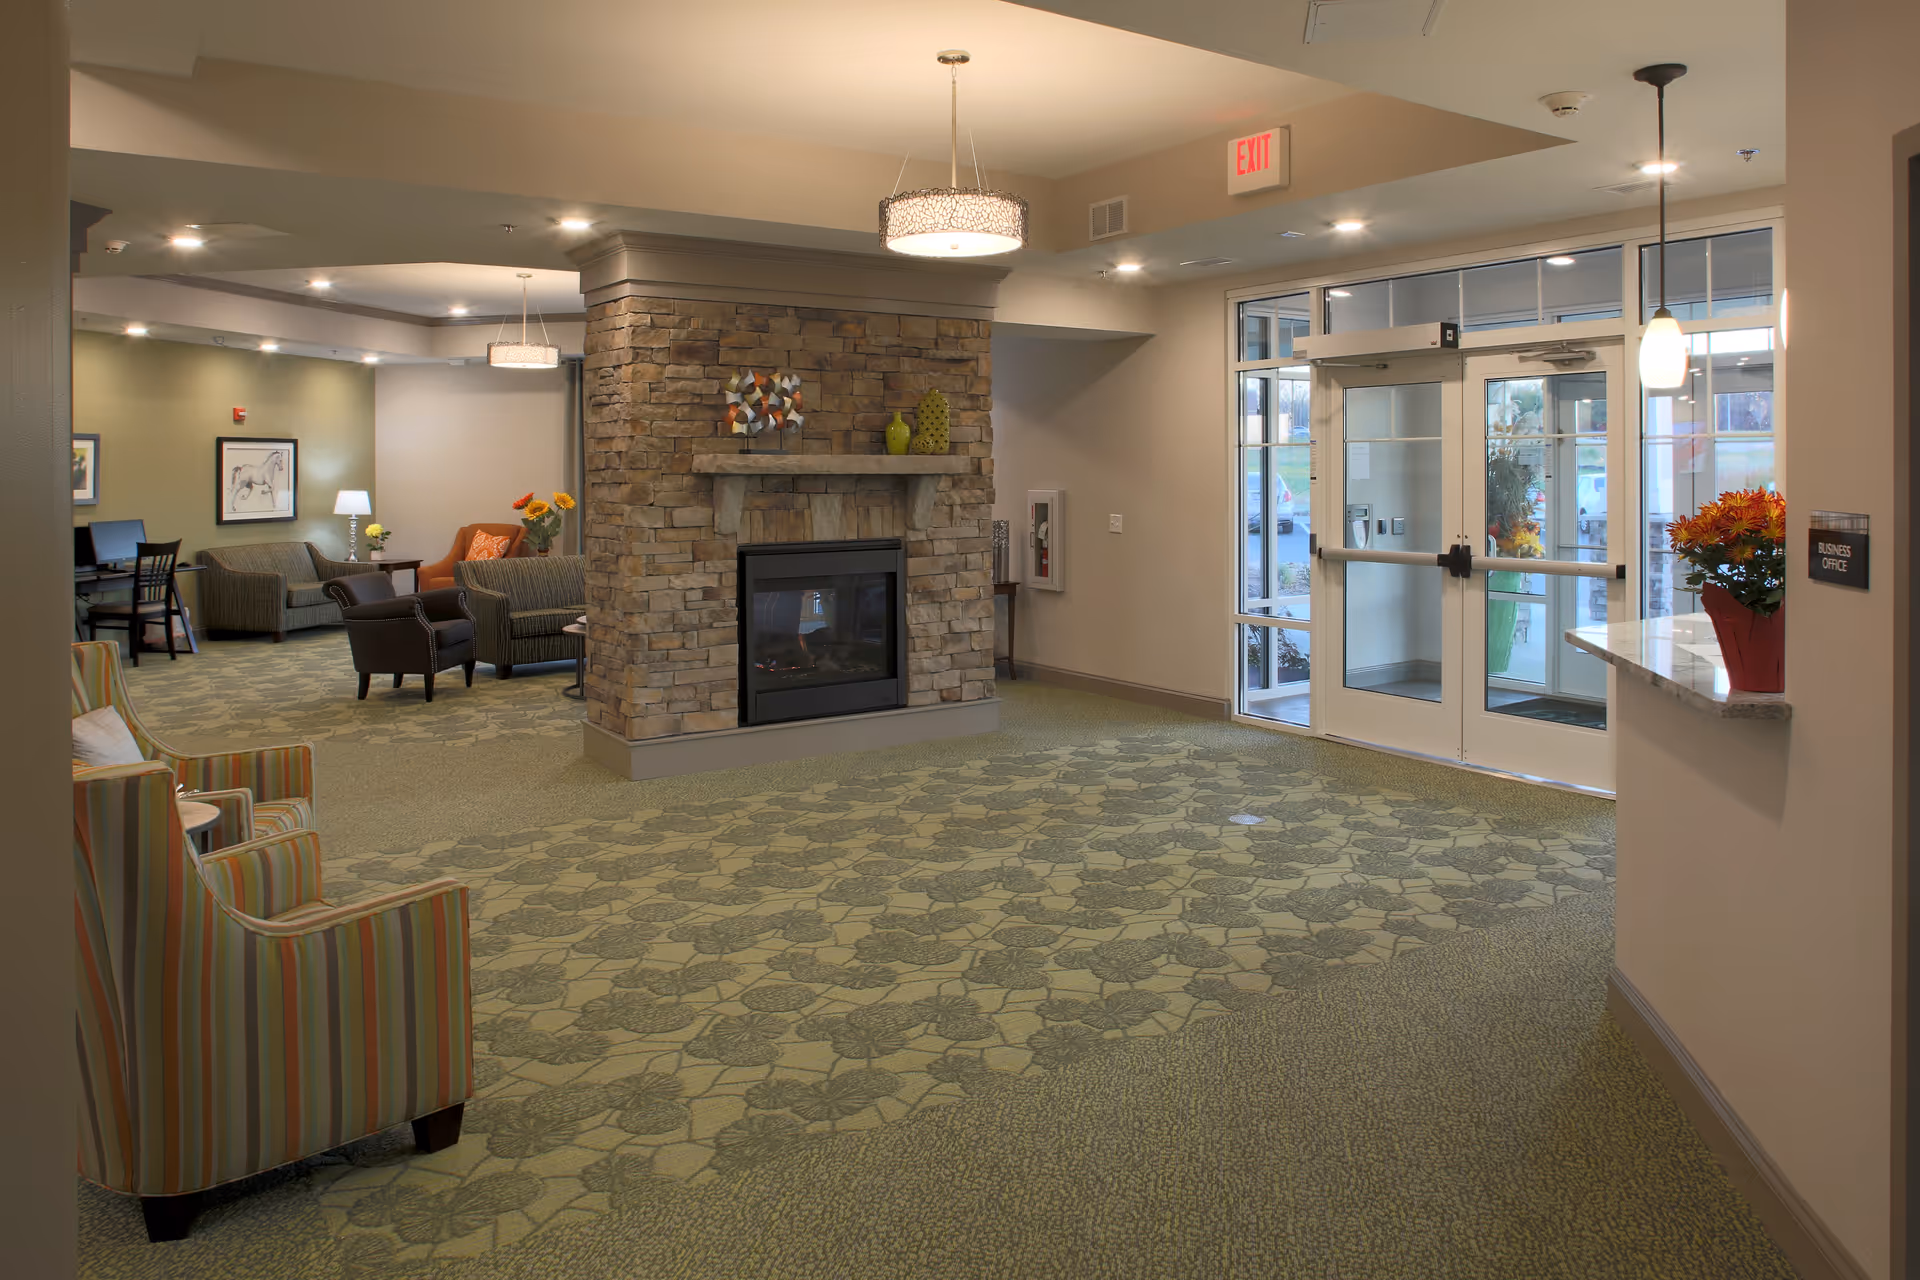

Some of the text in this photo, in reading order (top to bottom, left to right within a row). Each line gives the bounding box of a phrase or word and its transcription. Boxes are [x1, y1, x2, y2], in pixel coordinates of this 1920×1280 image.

[1237, 133, 1272, 176] EXIT
[1818, 542, 1851, 557] BUSINESS
[1822, 557, 1848, 571] OFFICE
